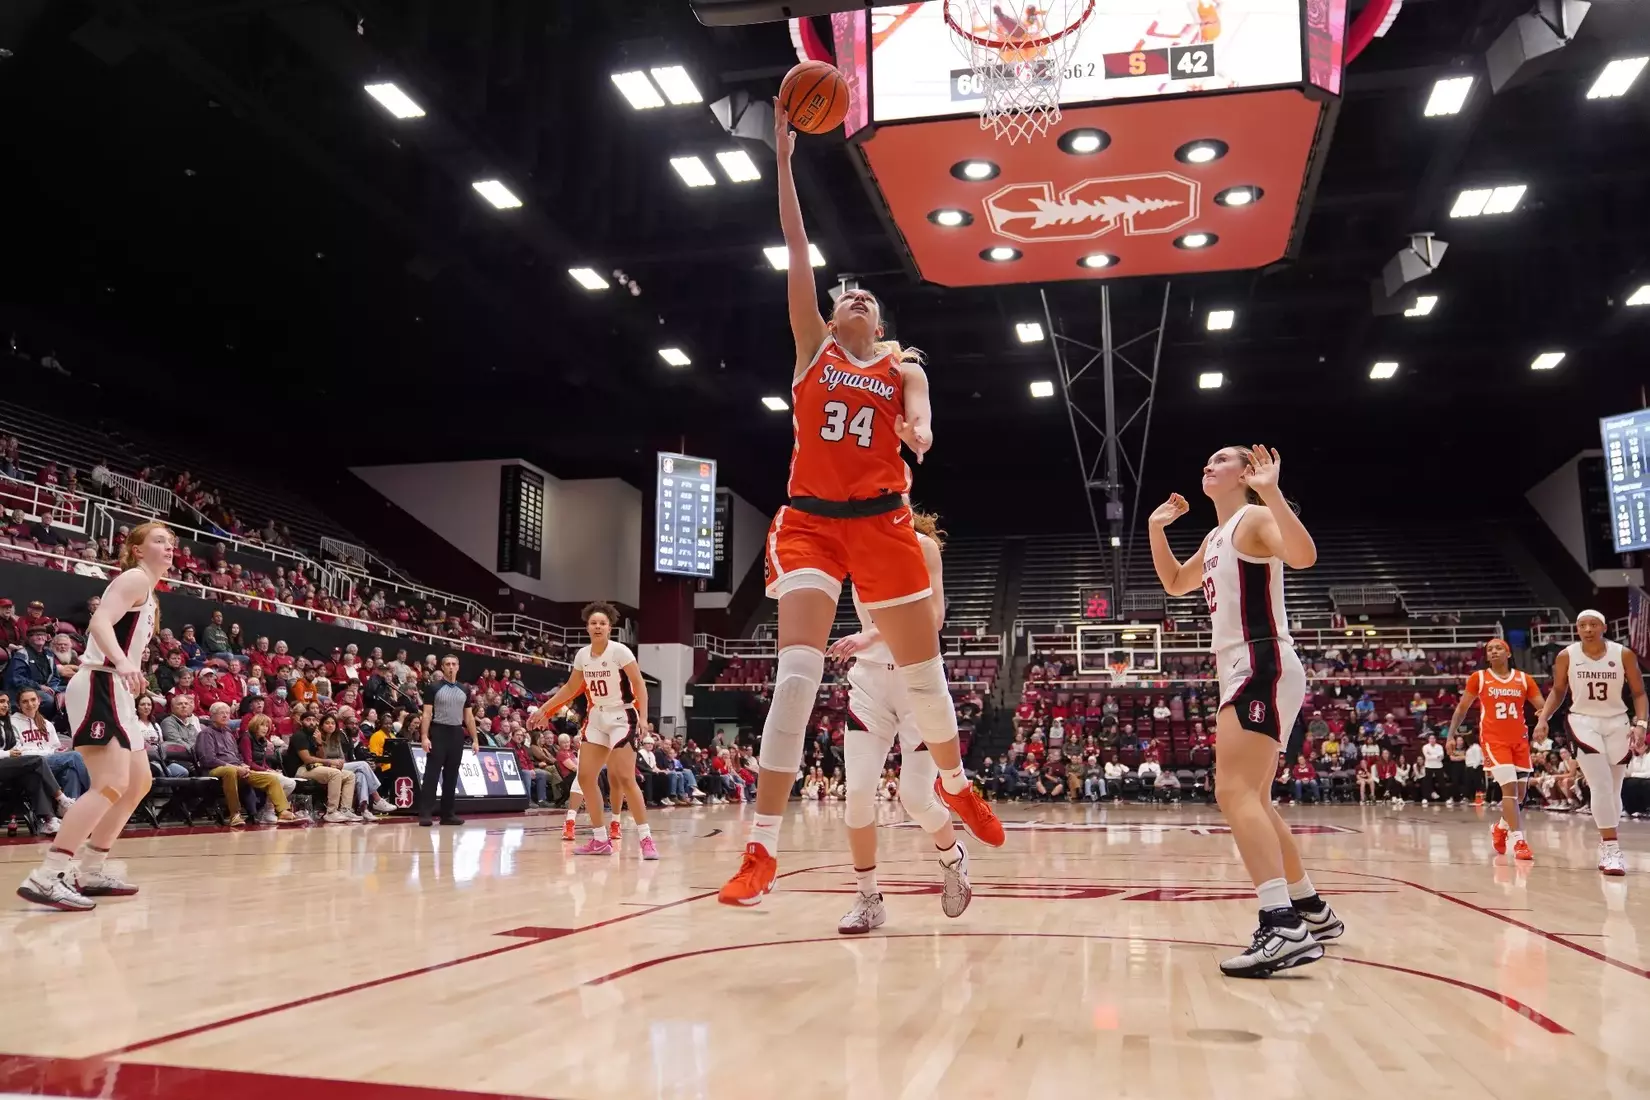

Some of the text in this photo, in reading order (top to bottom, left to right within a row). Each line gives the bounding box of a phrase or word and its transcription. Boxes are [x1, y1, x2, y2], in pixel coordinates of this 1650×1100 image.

[1128, 52, 1146, 75] S
[1176, 50, 1209, 74] 42
[798, 93, 825, 126] ELITE
[819, 364, 895, 401] Syracuse
[820, 400, 876, 448] 34
[1576, 671, 1617, 680] STANFORD
[590, 680, 608, 697] 40
[1488, 686, 1522, 700] Syracuse
[1586, 681, 1608, 701] 13
[1495, 702, 1519, 720] 24
[461, 762, 480, 777] 56.0
[484, 755, 499, 782] S
[502, 759, 517, 776] 42
